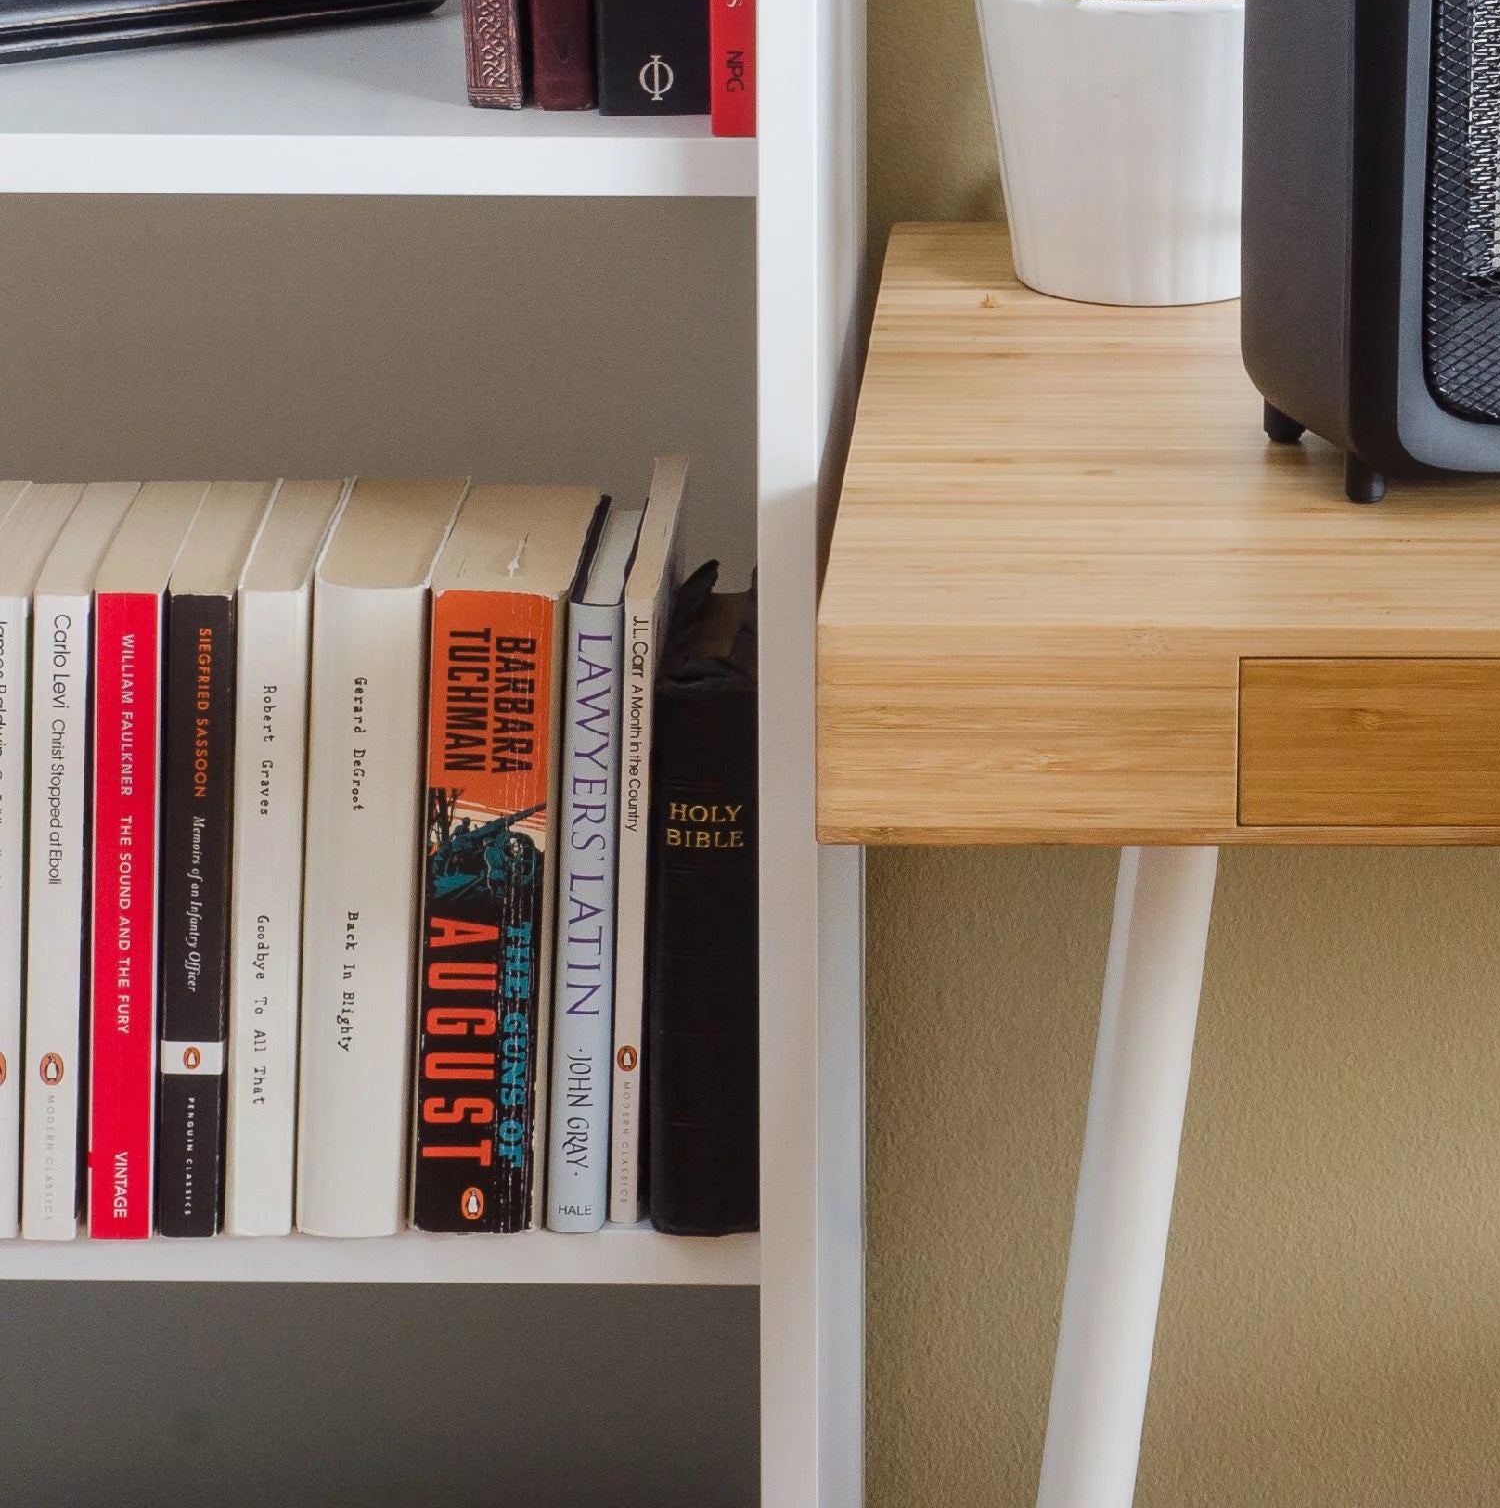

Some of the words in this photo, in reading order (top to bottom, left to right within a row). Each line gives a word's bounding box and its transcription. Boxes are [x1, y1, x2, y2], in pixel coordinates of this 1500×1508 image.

[726, 50, 744, 93] NPG
[53, 614, 71, 668] Carlo
[632, 641, 648, 679] Carr
[53, 673, 70, 709] Levi
[121, 633, 135, 704] WILLIAM
[197, 628, 212, 710] SIEGFRIED
[631, 684, 644, 694] A
[262, 686, 278, 743] Robert
[353, 676, 368, 734] Gerard
[444, 627, 492, 772] TUCHMAN
[491, 636, 537, 775] BARBARA
[630, 696, 643, 739] Month
[51, 720, 66, 759] Christ
[120, 711, 133, 796] FAULKNER
[193, 718, 209, 798] SASSOON
[628, 755, 641, 776] the
[630, 741, 642, 752] in
[49, 763, 64, 828] Stopped
[259, 760, 274, 816] Graves
[352, 749, 367, 811] DeGroot
[625, 778, 641, 833] Country
[120, 816, 132, 846] THE
[668, 802, 744, 822] HOLY
[49, 830, 63, 847] at
[191, 815, 206, 865] Memoirs
[666, 829, 745, 848] BIBLE
[48, 850, 62, 885] Eboli
[118, 852, 132, 910] SOUND
[186, 868, 203, 882] of
[190, 883, 200, 897] an
[118, 917, 131, 951] AND
[185, 900, 203, 949] Infantry
[252, 915, 270, 980] Goodbye
[344, 911, 359, 951] Back
[565, 872, 605, 1017] LATIN
[118, 957, 130, 988] THE
[184, 951, 201, 992] Officer
[343, 964, 355, 980] In
[505, 922, 531, 1000] THE
[117, 995, 129, 1034] FURY
[254, 997, 268, 1015] To
[336, 992, 355, 1052] Blighty
[254, 1030, 266, 1053] All
[422, 916, 501, 1167] AUGUST
[501, 1013, 529, 1107] GUNS
[252, 1066, 266, 1105] That
[567, 1054, 593, 1108] JOHN
[186, 1096, 195, 1152] PENGUIN
[622, 1081, 631, 1135] MODERN
[498, 1116, 524, 1168] OF
[561, 1116, 590, 1169] GRAY
[114, 1151, 128, 1219] VINTAGE
[184, 1158, 193, 1216] CLASSICS
[619, 1141, 629, 1204] CLASSICS
[558, 1204, 593, 1216] HALE
